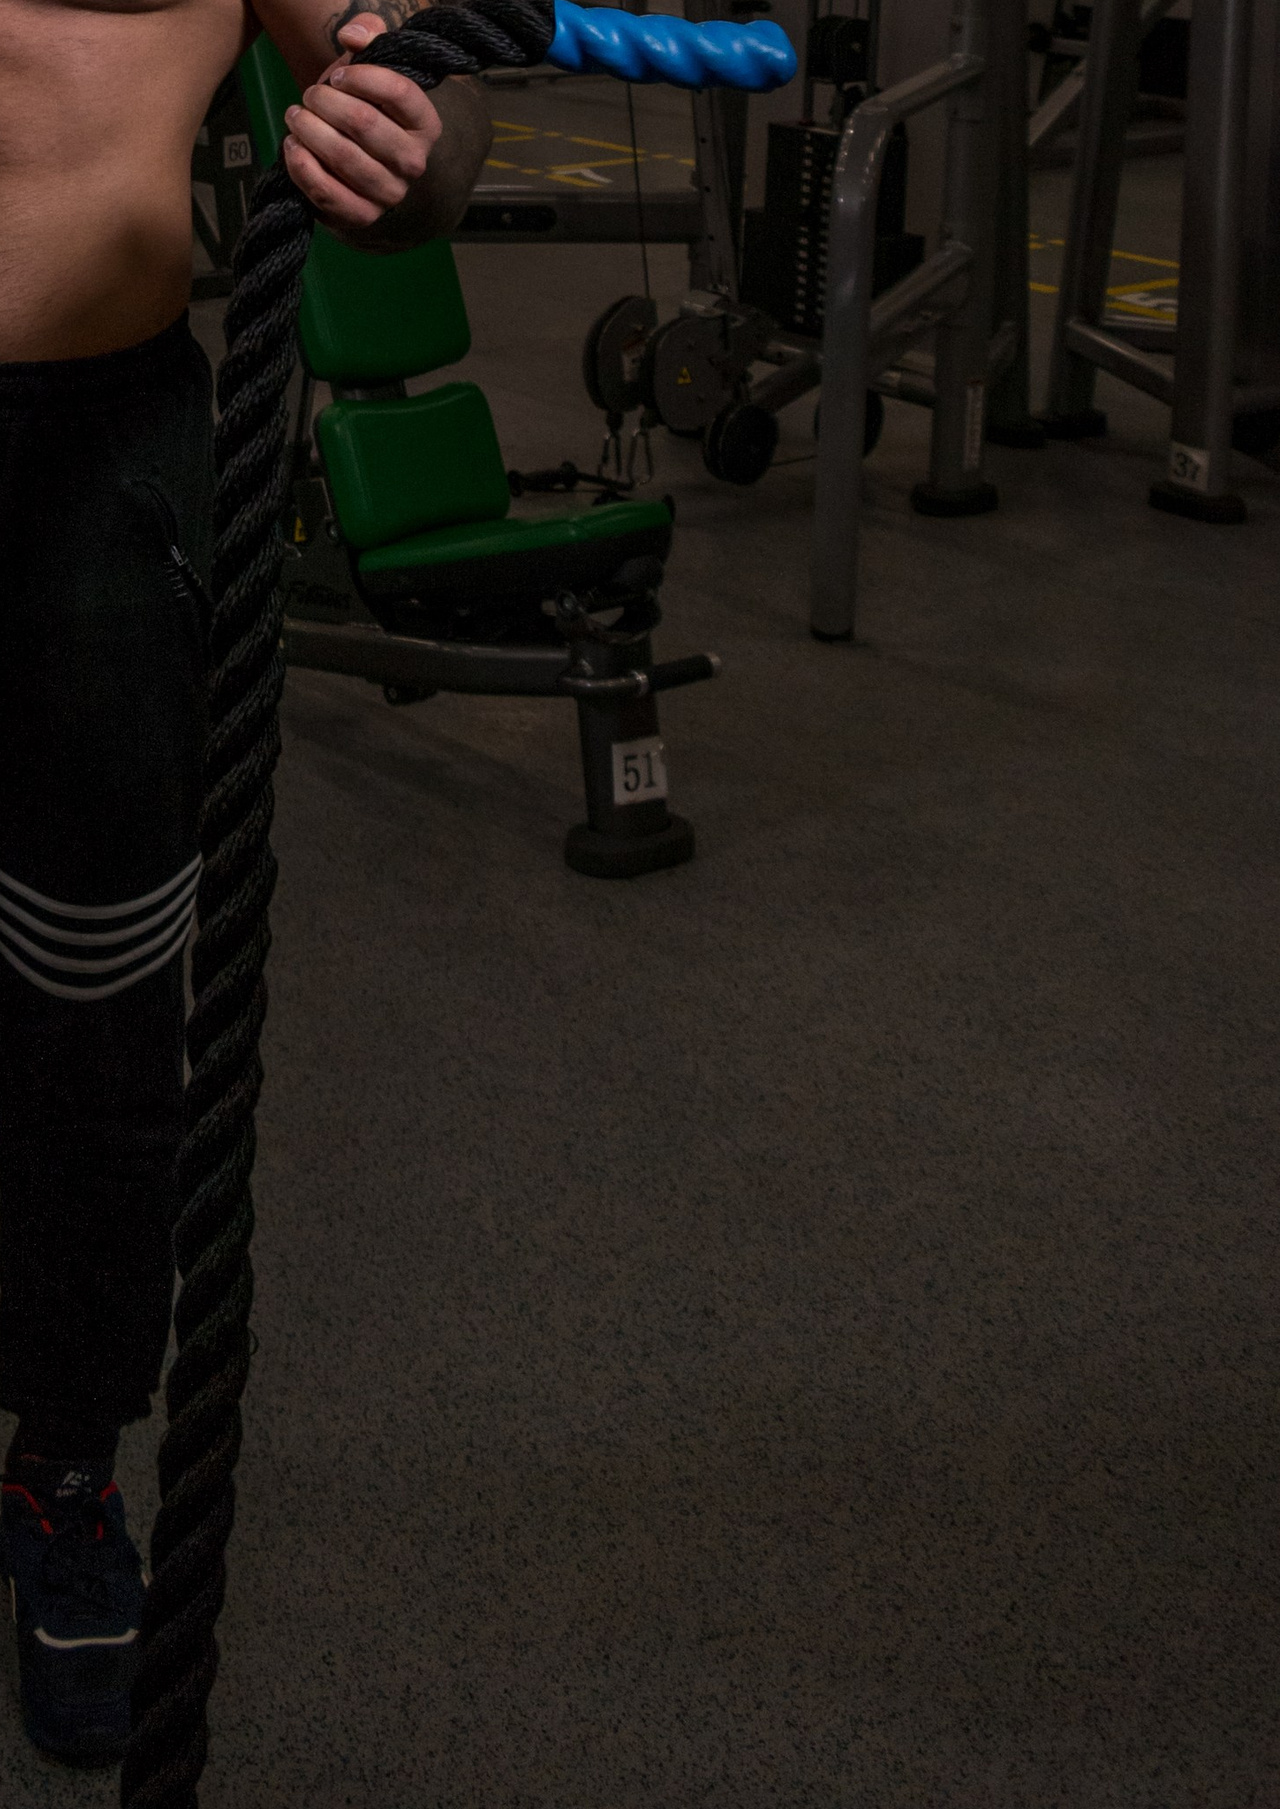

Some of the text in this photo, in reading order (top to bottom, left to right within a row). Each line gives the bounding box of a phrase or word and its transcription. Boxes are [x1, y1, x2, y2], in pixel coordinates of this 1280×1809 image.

[228, 140, 248, 162] 60
[1172, 452, 1201, 482] 37
[623, 752, 657, 792] 51
